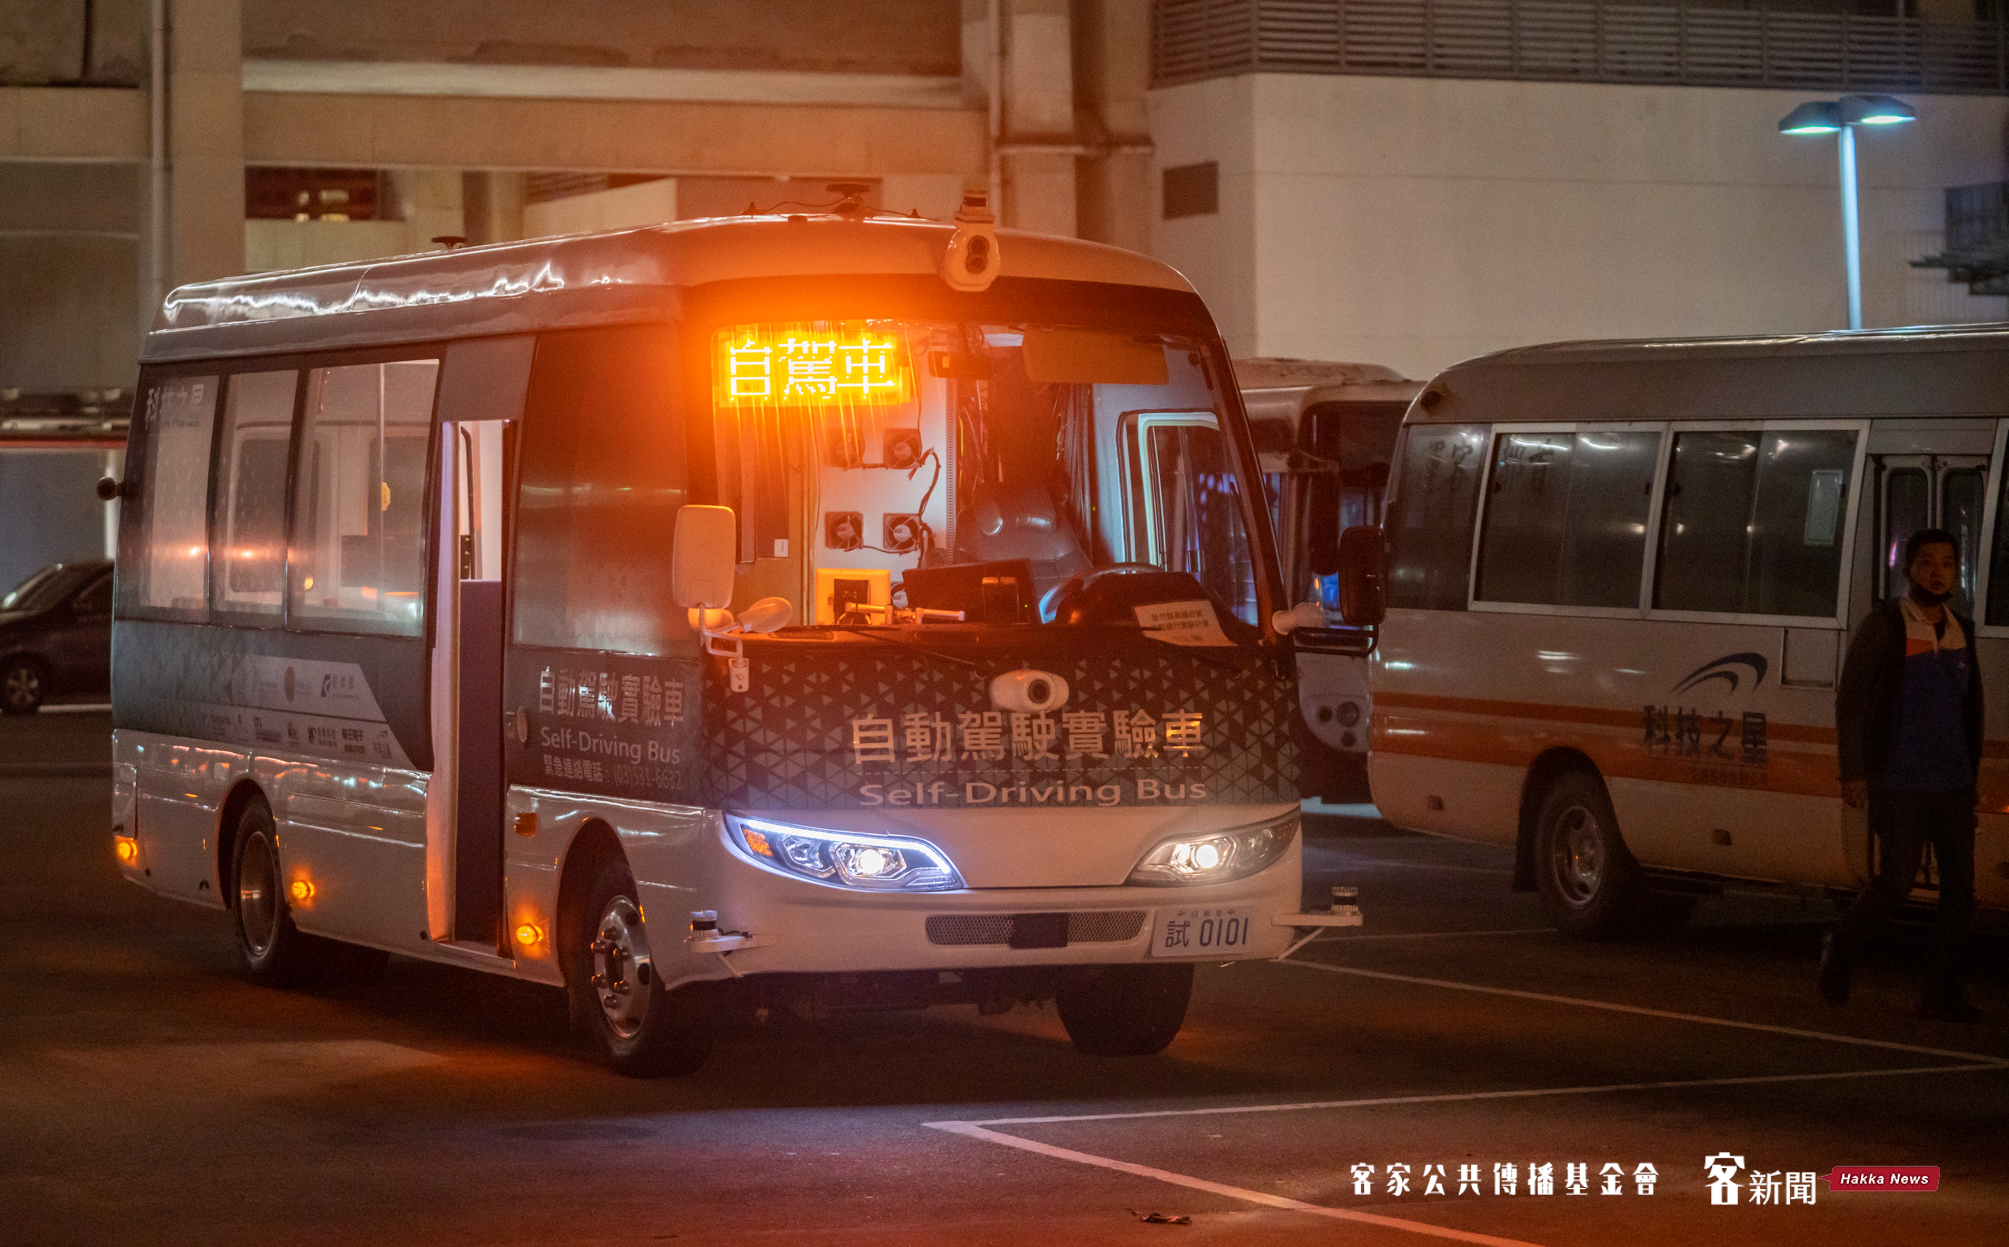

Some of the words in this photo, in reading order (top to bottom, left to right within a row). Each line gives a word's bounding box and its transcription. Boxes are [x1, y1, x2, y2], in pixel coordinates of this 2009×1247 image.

[728, 338, 896, 400] 自駕車
[539, 666, 684, 728] 自動駕駛實驗車
[541, 727, 642, 765] Self-Driving
[648, 740, 681, 764] Bus
[852, 709, 1205, 765] 自動駕駛實驗車
[1643, 705, 1768, 763] 科技之星
[858, 780, 1122, 807] Self-Driving
[1137, 778, 1207, 800] Bus
[1199, 917, 1249, 947] 0101
